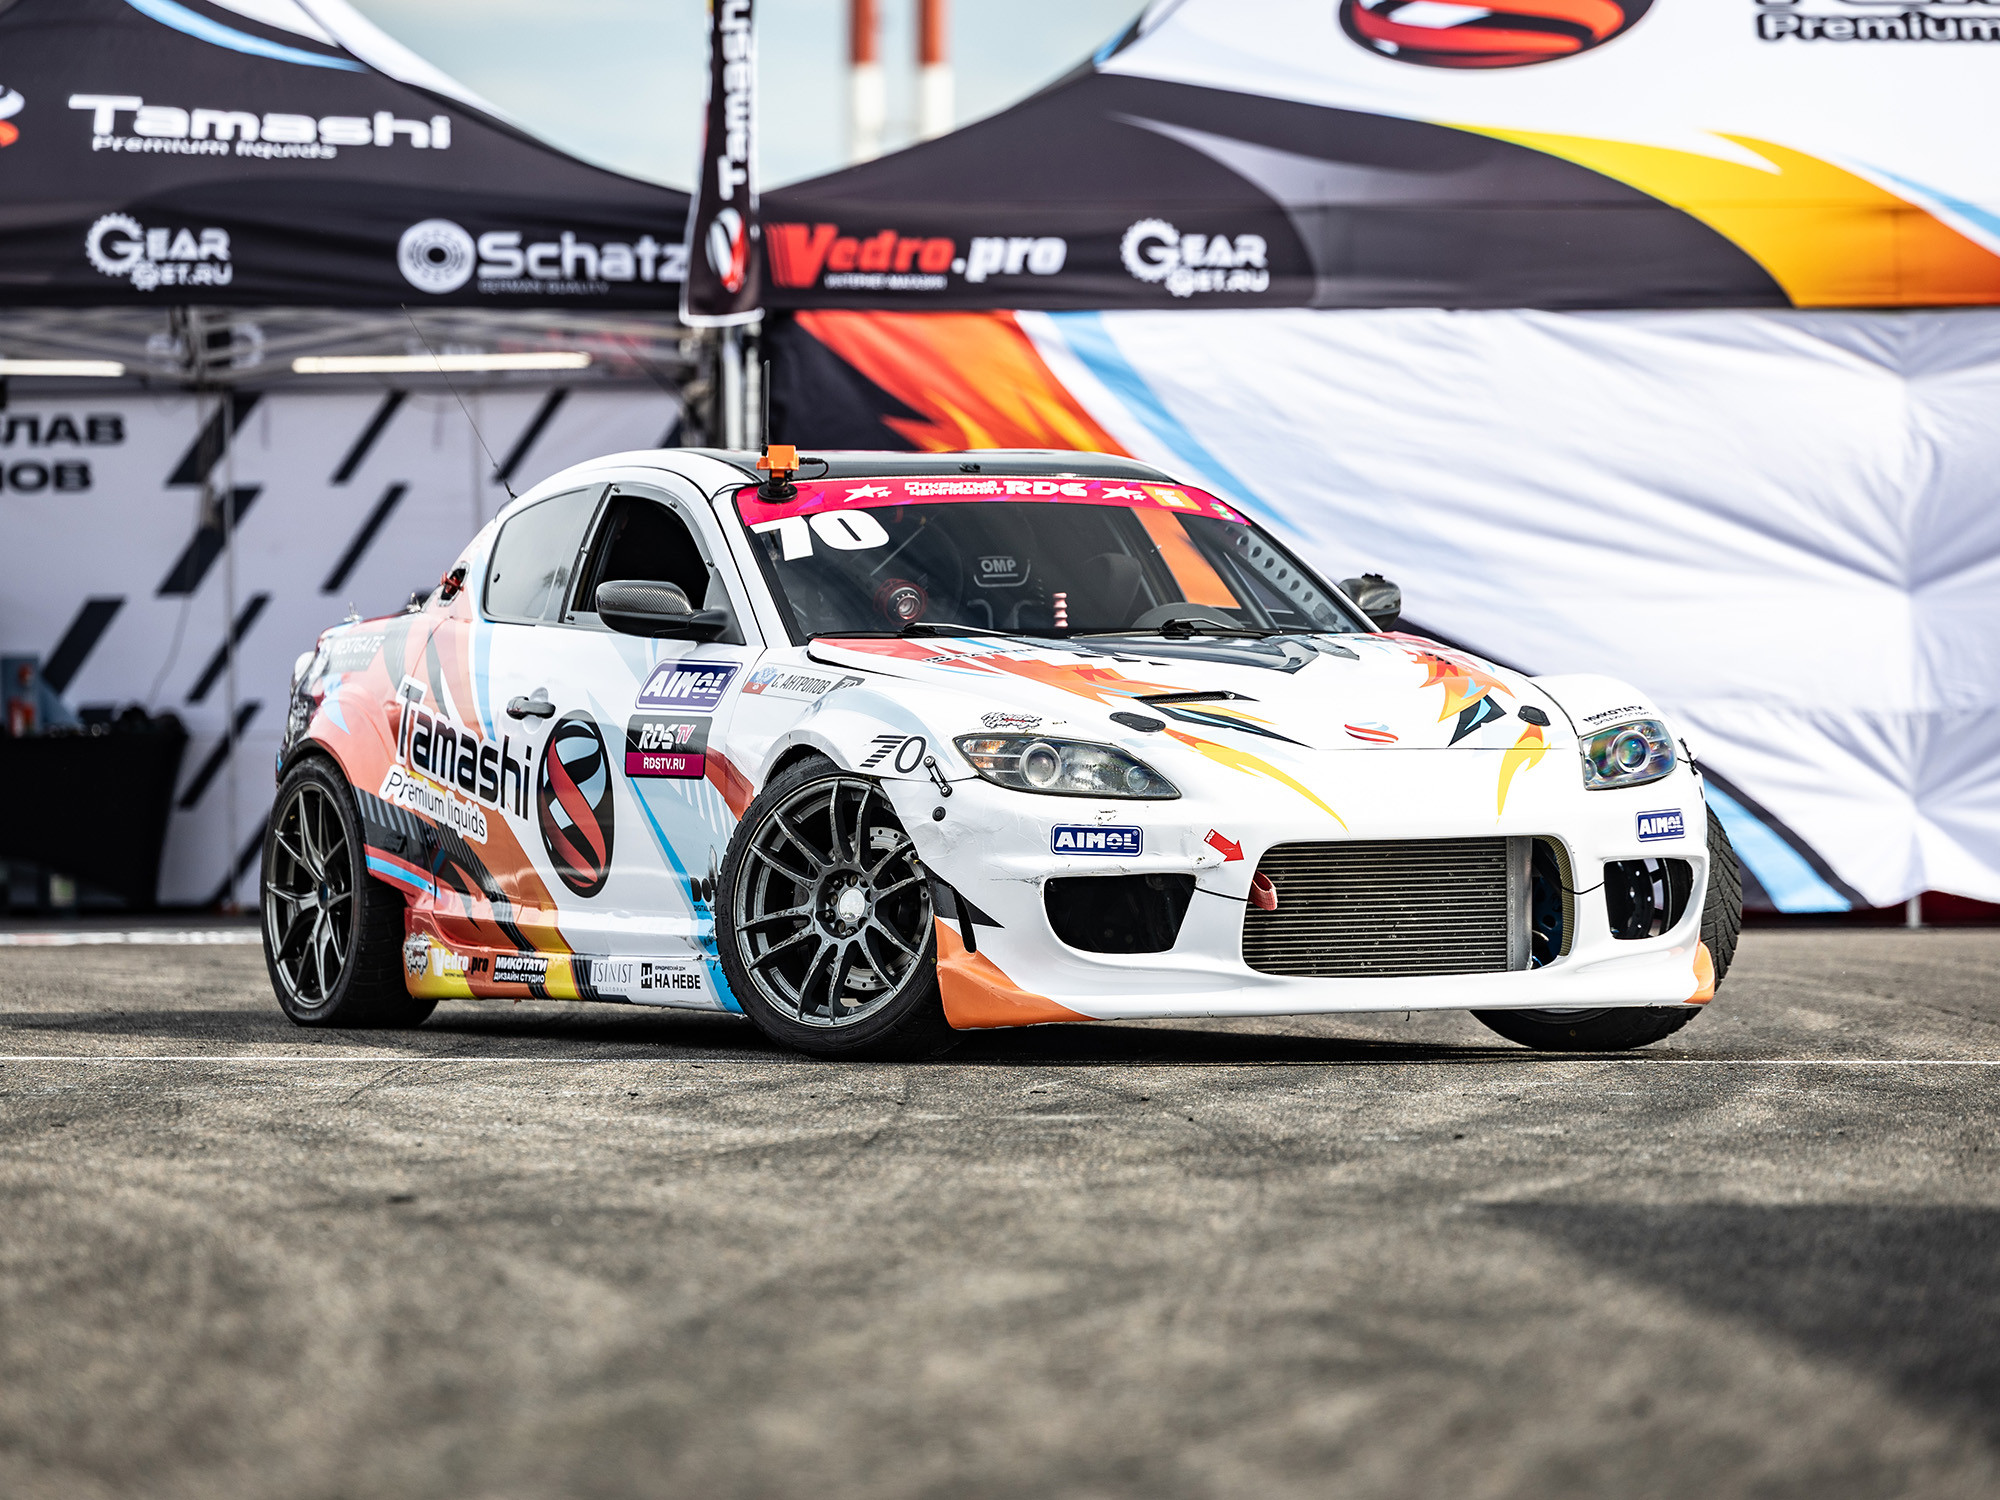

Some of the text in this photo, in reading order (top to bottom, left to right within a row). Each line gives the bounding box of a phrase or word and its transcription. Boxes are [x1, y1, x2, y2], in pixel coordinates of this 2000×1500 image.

[68, 93, 451, 150] Tamashi
[477, 230, 691, 283] Schatz
[764, 222, 1068, 290] Vedro.pro
[749, 509, 890, 562] 70
[981, 559, 1017, 573] OMP
[642, 670, 727, 700] AIMOL
[780, 674, 832, 695] АНТРОПОВ
[399, 682, 533, 822] Tamashi
[643, 757, 686, 771] RDSTV.RU
[859, 734, 927, 774] 70
[385, 772, 486, 838] Premium liquids
[1639, 815, 1684, 835] AIMOL
[1055, 831, 1137, 850] AIMOL
[431, 948, 489, 977] Vedro.pro
[495, 956, 548, 972] МИКОТАТИ
[593, 963, 633, 983] TSINIST
[493, 971, 545, 983] ДИЗАЙН СТУДИО
[655, 973, 701, 989] НА НЕВЕ
